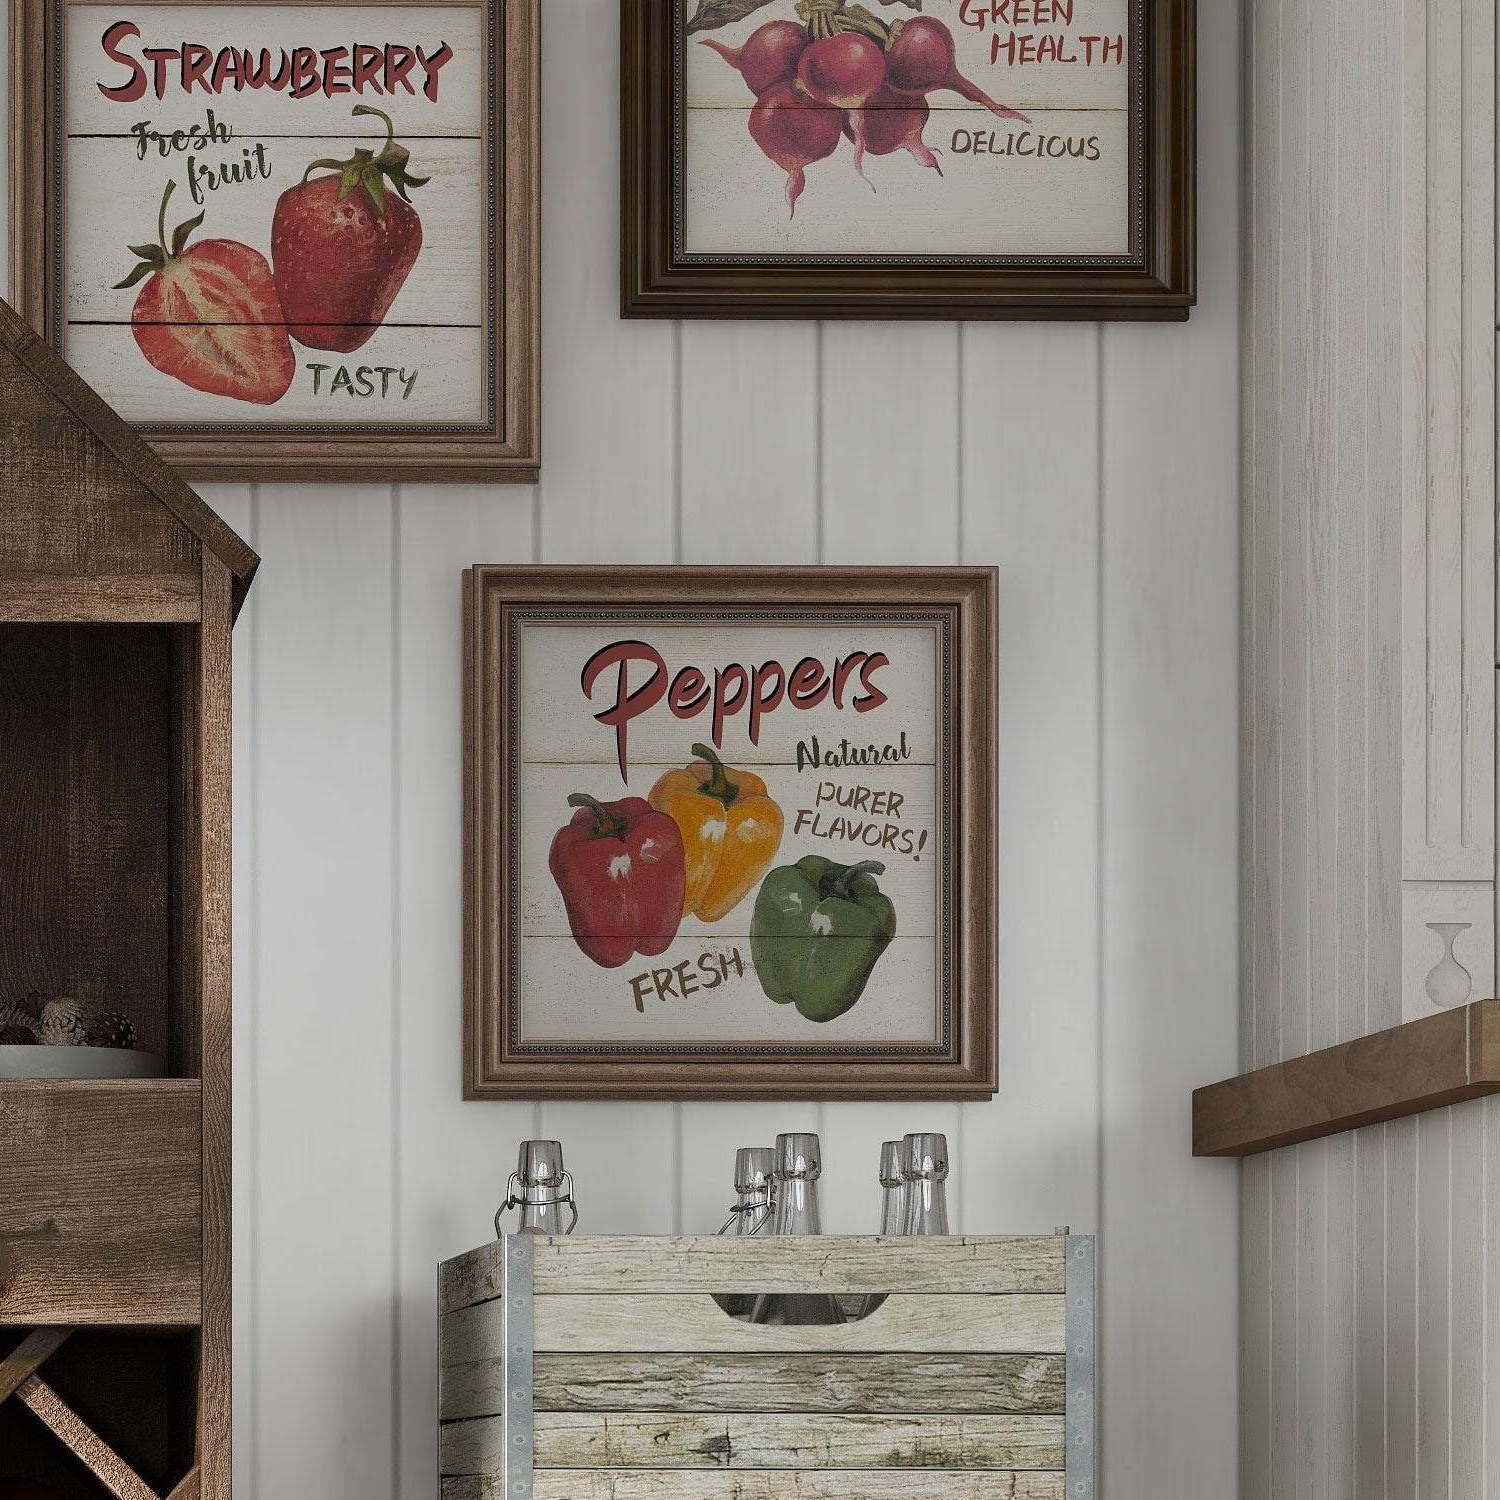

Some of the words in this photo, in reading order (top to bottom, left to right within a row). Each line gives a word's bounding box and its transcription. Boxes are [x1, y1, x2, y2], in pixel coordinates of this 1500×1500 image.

[959, 0, 1074, 31] GREEN
[97, 20, 453, 103] STRAWBERRY
[990, 31, 1123, 66] HEALTH
[131, 108, 233, 161] Fresh
[951, 129, 1101, 161] DELICIOUS
[186, 143, 273, 205] fruit
[306, 363, 419, 400] TASTY
[581, 640, 890, 786] Peppers
[796, 732, 912, 774] Natural
[815, 781, 905, 818] PURER
[793, 809, 929, 863] FLAVORS!
[628, 948, 745, 1013] FRESH
